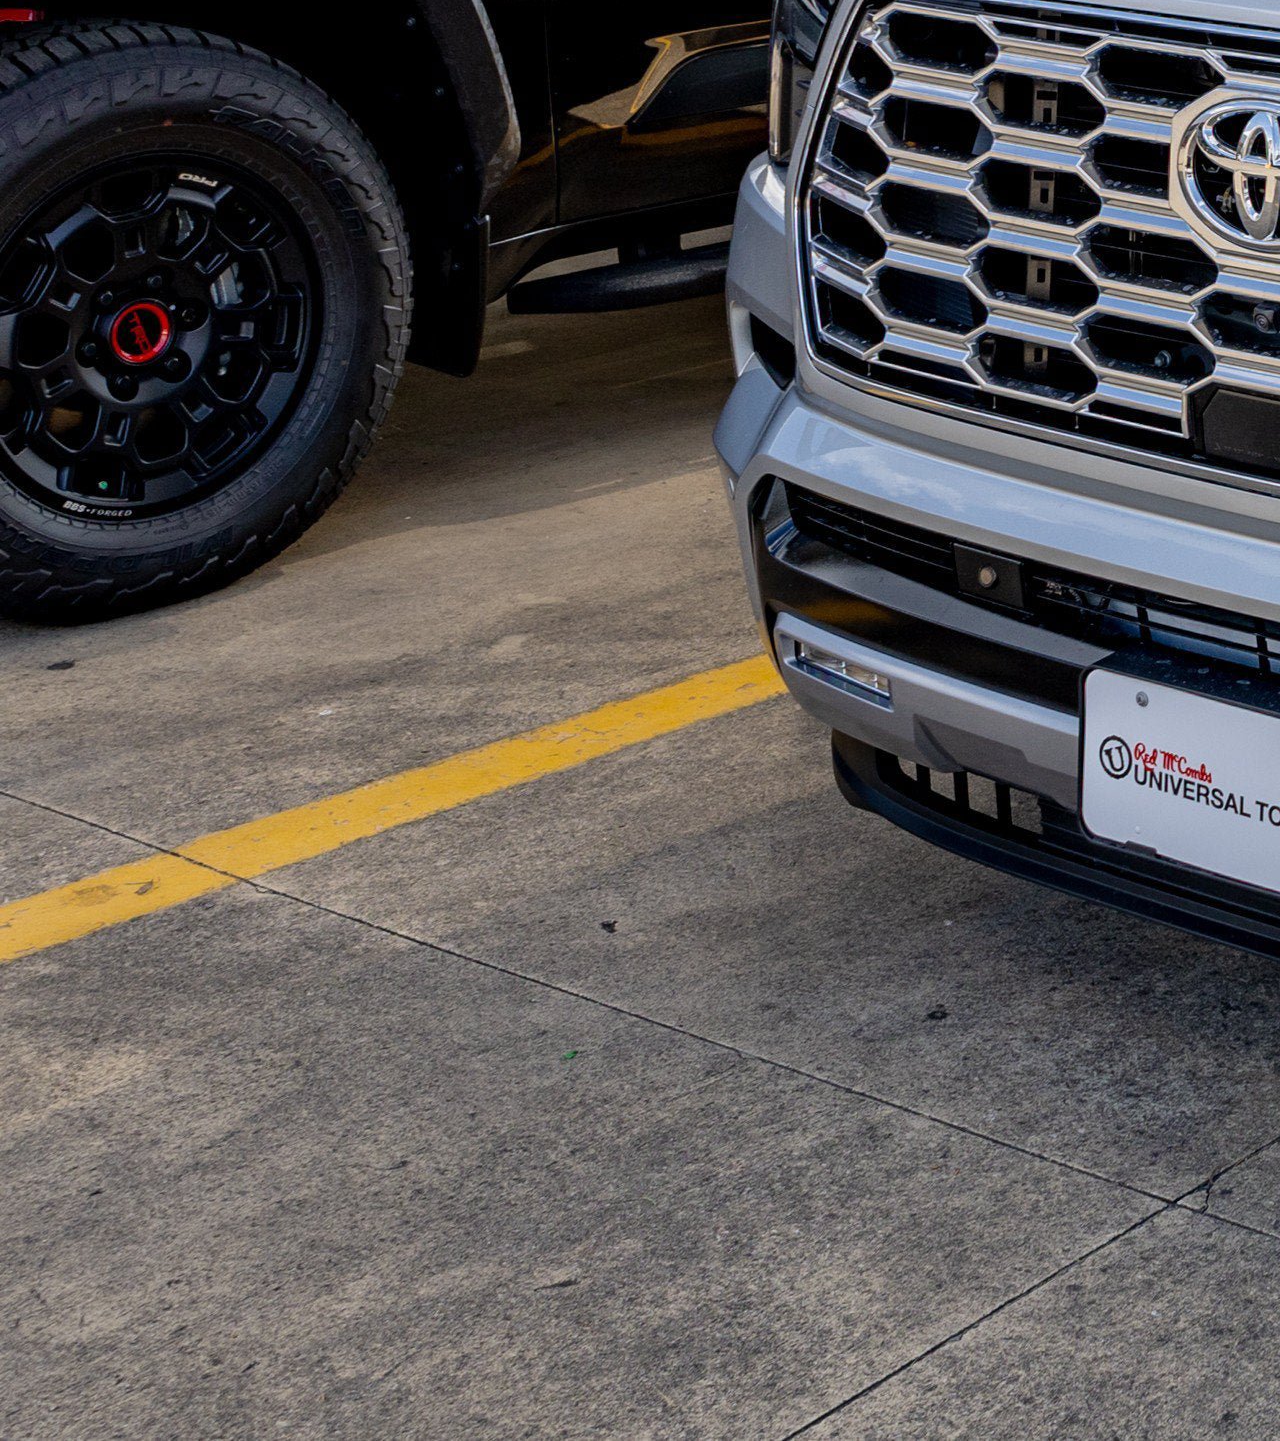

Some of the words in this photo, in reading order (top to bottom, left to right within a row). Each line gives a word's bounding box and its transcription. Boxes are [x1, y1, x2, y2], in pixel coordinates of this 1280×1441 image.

[1134, 742, 1157, 773] Red
[1159, 750, 1213, 784] McCombs
[1134, 764, 1252, 818] UNIVERSAL
